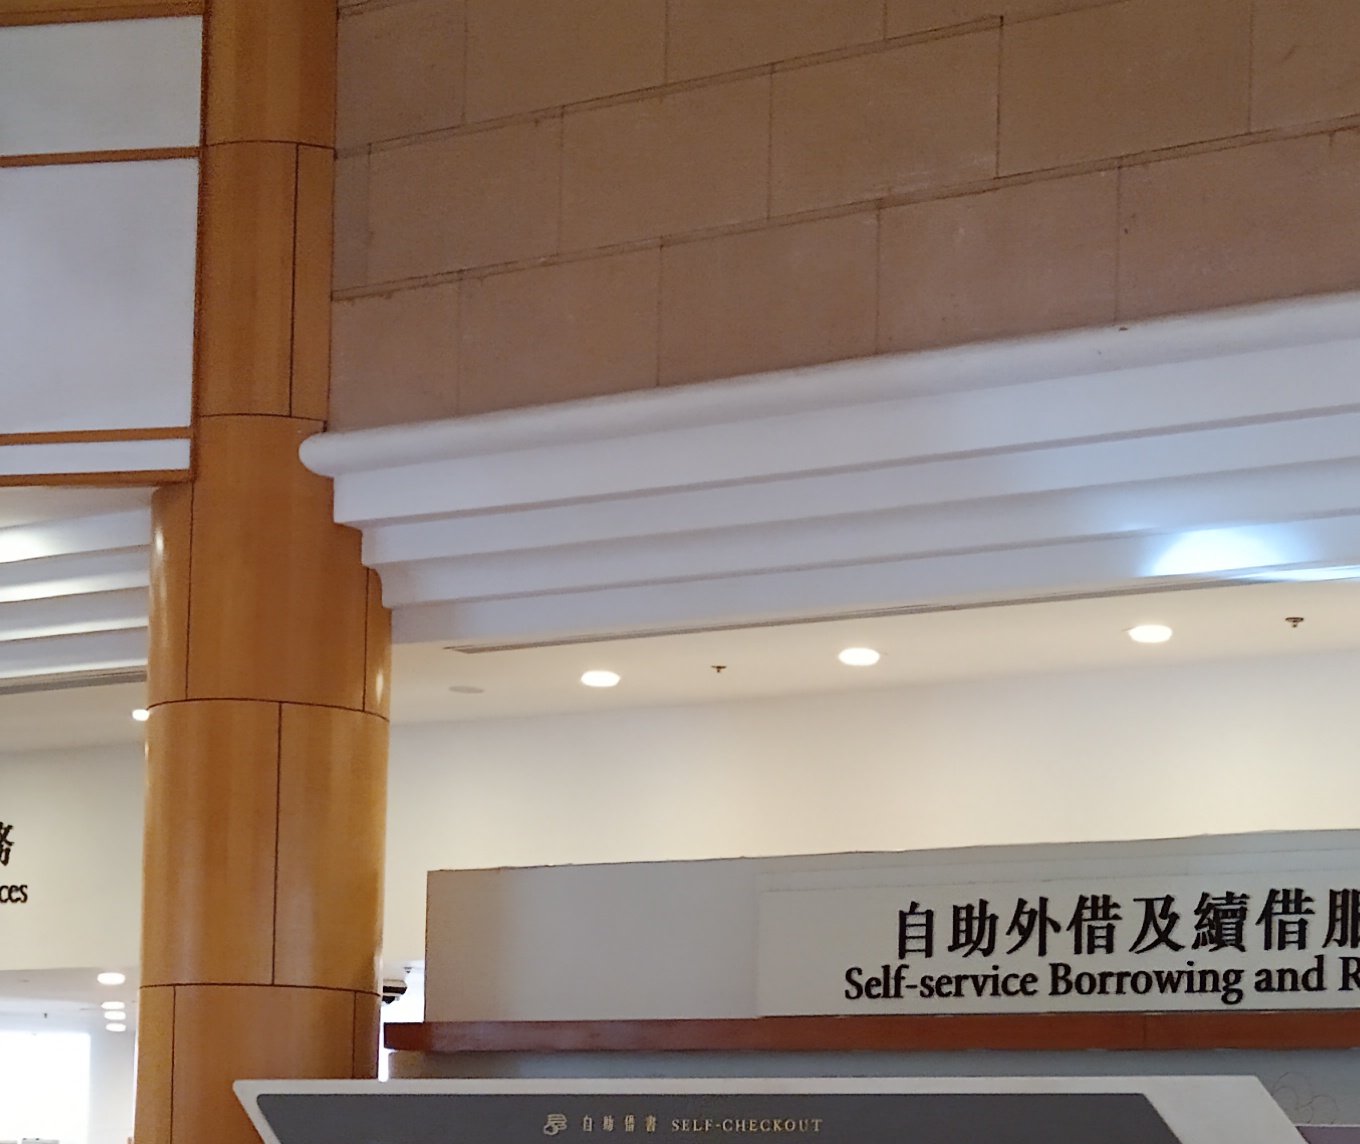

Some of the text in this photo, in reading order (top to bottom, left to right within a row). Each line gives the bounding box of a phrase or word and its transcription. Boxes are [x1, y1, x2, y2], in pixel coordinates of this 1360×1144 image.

[844, 966, 1039, 1001] Self-service
[1048, 960, 1243, 1004] Borrowing
[1254, 955, 1325, 993] and
[582, 1115, 657, 1132] 自助借書
[671, 1118, 823, 1133] SELF-CHECKOUT
